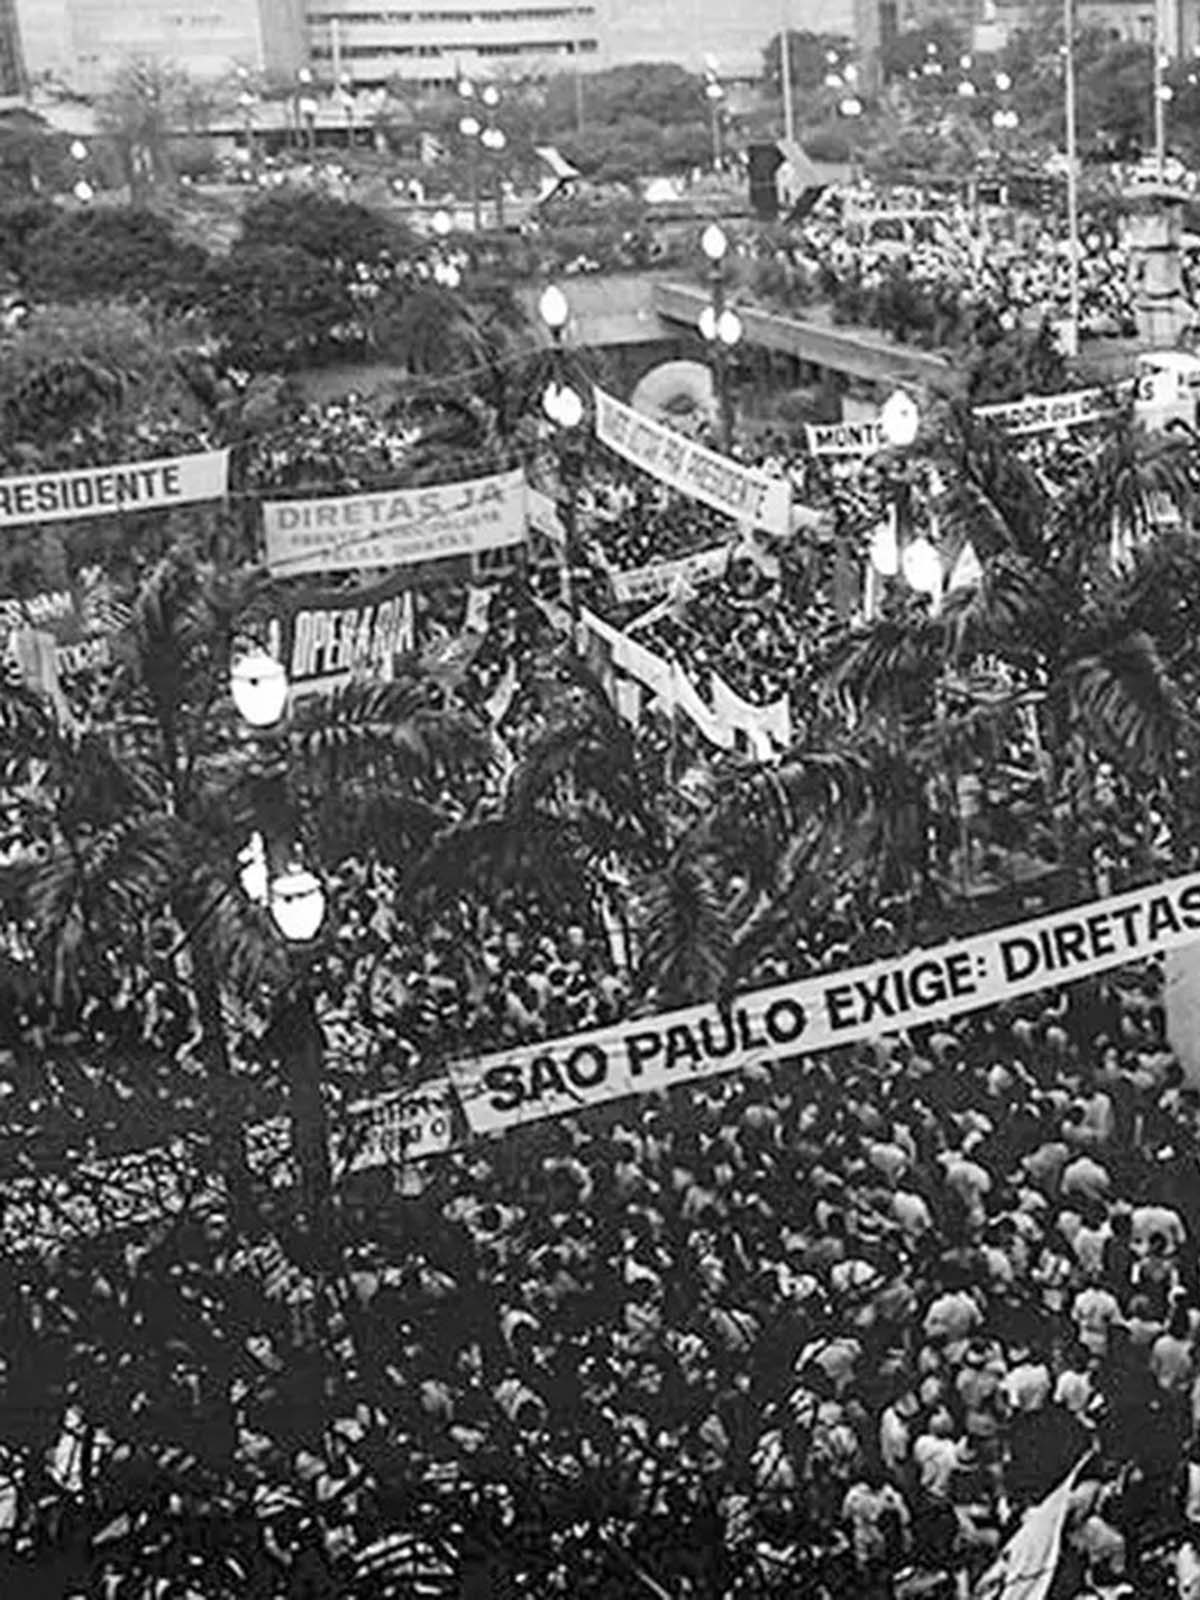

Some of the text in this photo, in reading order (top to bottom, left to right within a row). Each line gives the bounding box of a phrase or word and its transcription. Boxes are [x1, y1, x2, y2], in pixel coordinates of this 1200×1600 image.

[276, 492, 441, 530] DIRETAS
[624, 999, 807, 1076] PAULO
[824, 952, 987, 1030] EXIGE:
